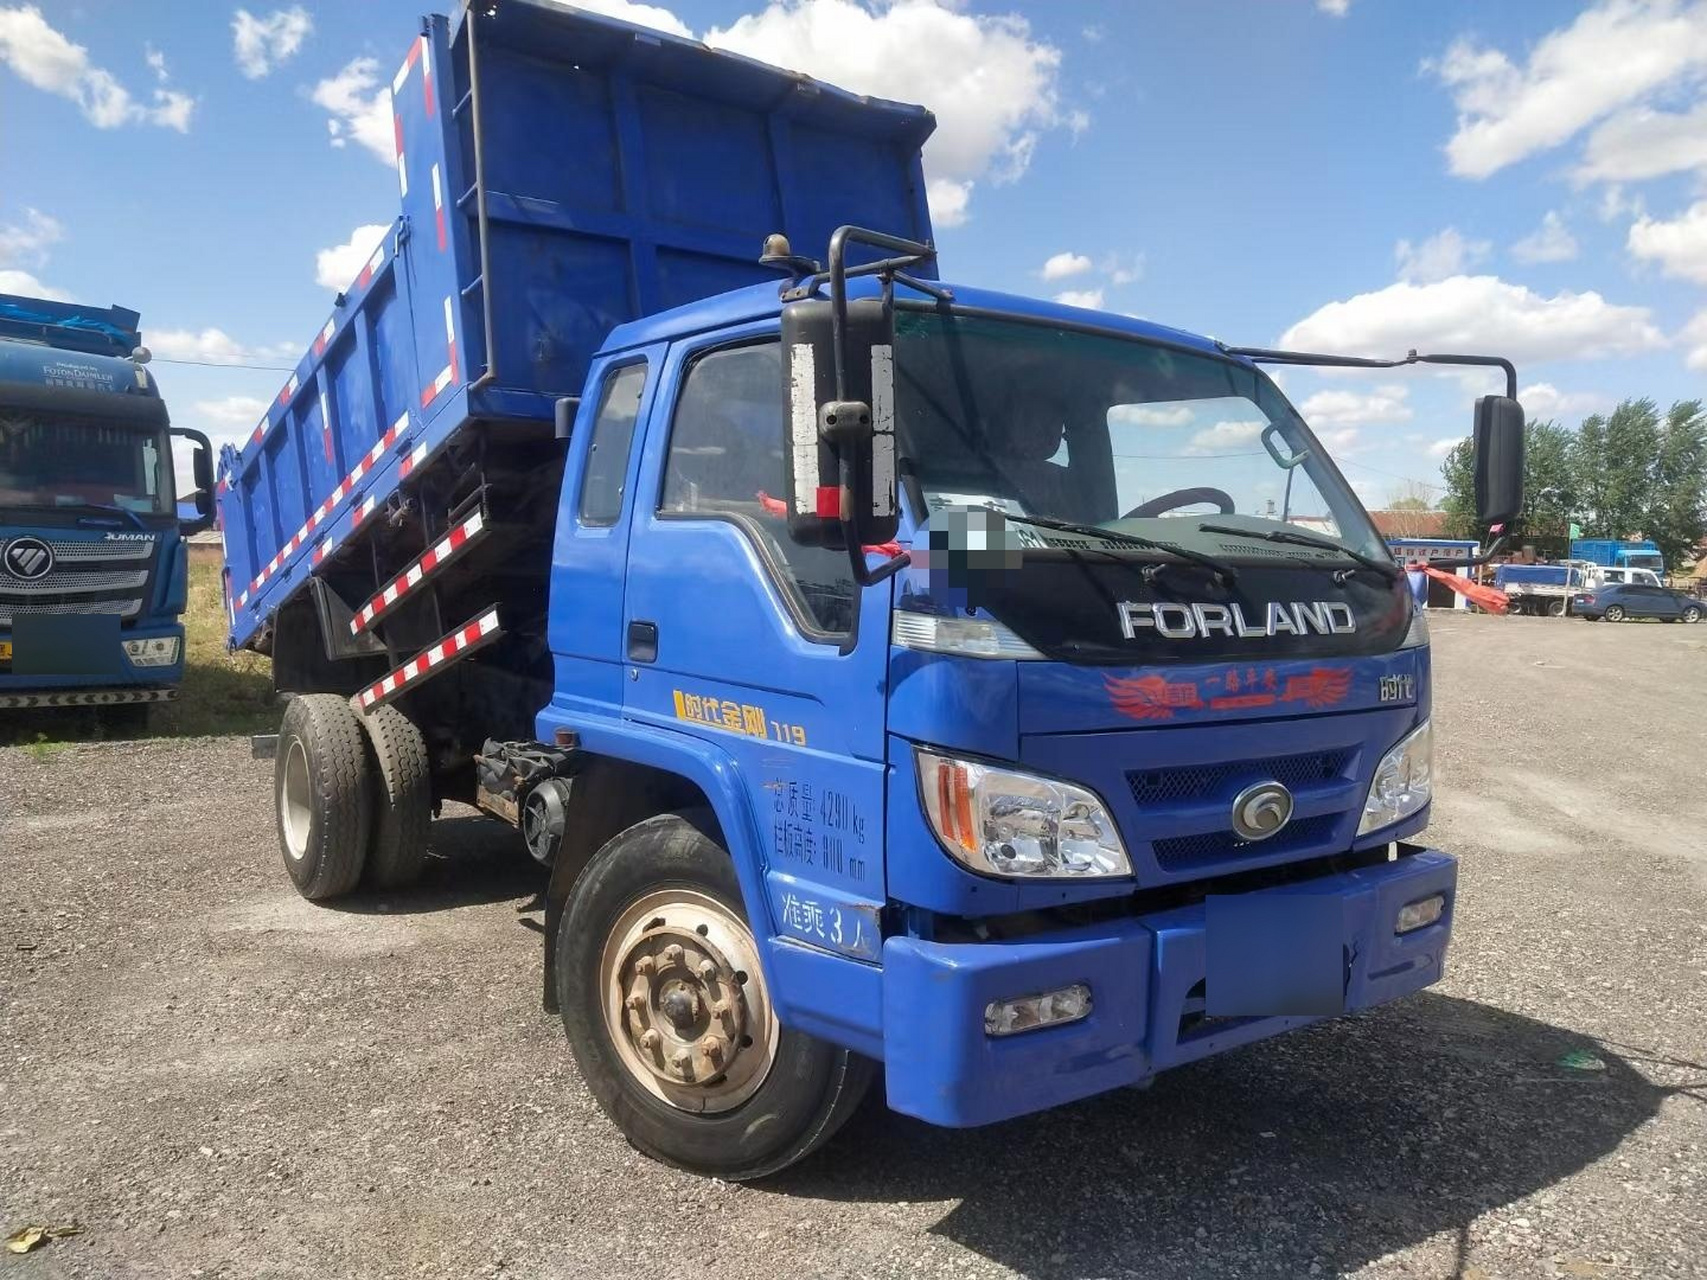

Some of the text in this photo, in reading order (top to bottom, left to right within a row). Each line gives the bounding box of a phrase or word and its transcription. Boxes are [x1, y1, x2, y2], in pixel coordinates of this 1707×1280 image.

[1116, 601, 1356, 639] FORLAND
[1379, 673, 1414, 702] 时代
[848, 857, 866, 883] mm
